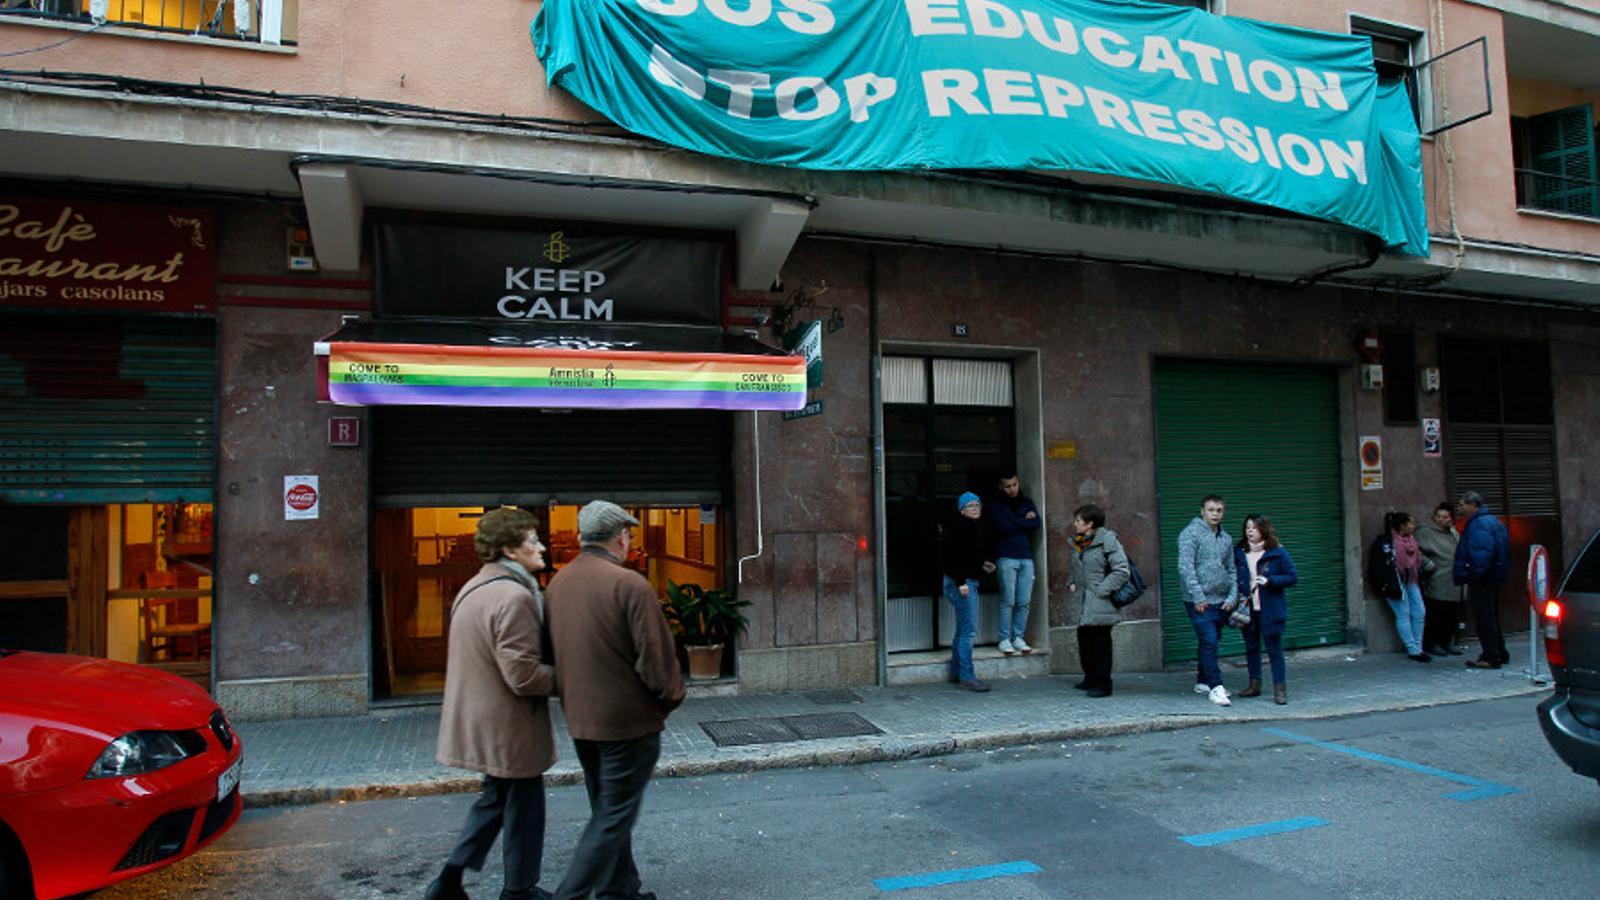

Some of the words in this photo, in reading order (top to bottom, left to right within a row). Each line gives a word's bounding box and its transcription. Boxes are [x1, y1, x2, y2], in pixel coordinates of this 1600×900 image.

[907, 0, 1350, 112] EDUCATION
[648, 43, 897, 123] STOP
[921, 68, 1368, 185] REPRESSION
[505, 266, 606, 293] KEEP
[0, 280, 48, 298] jars
[61, 285, 165, 302] casolans
[496, 295, 614, 321] CALM
[349, 363, 381, 373] COME
[384, 365, 400, 374] TO
[550, 367, 595, 379] Amnistia
[742, 373, 768, 382] COME
[772, 374, 785, 382] TO
[338, 423, 350, 441] R
